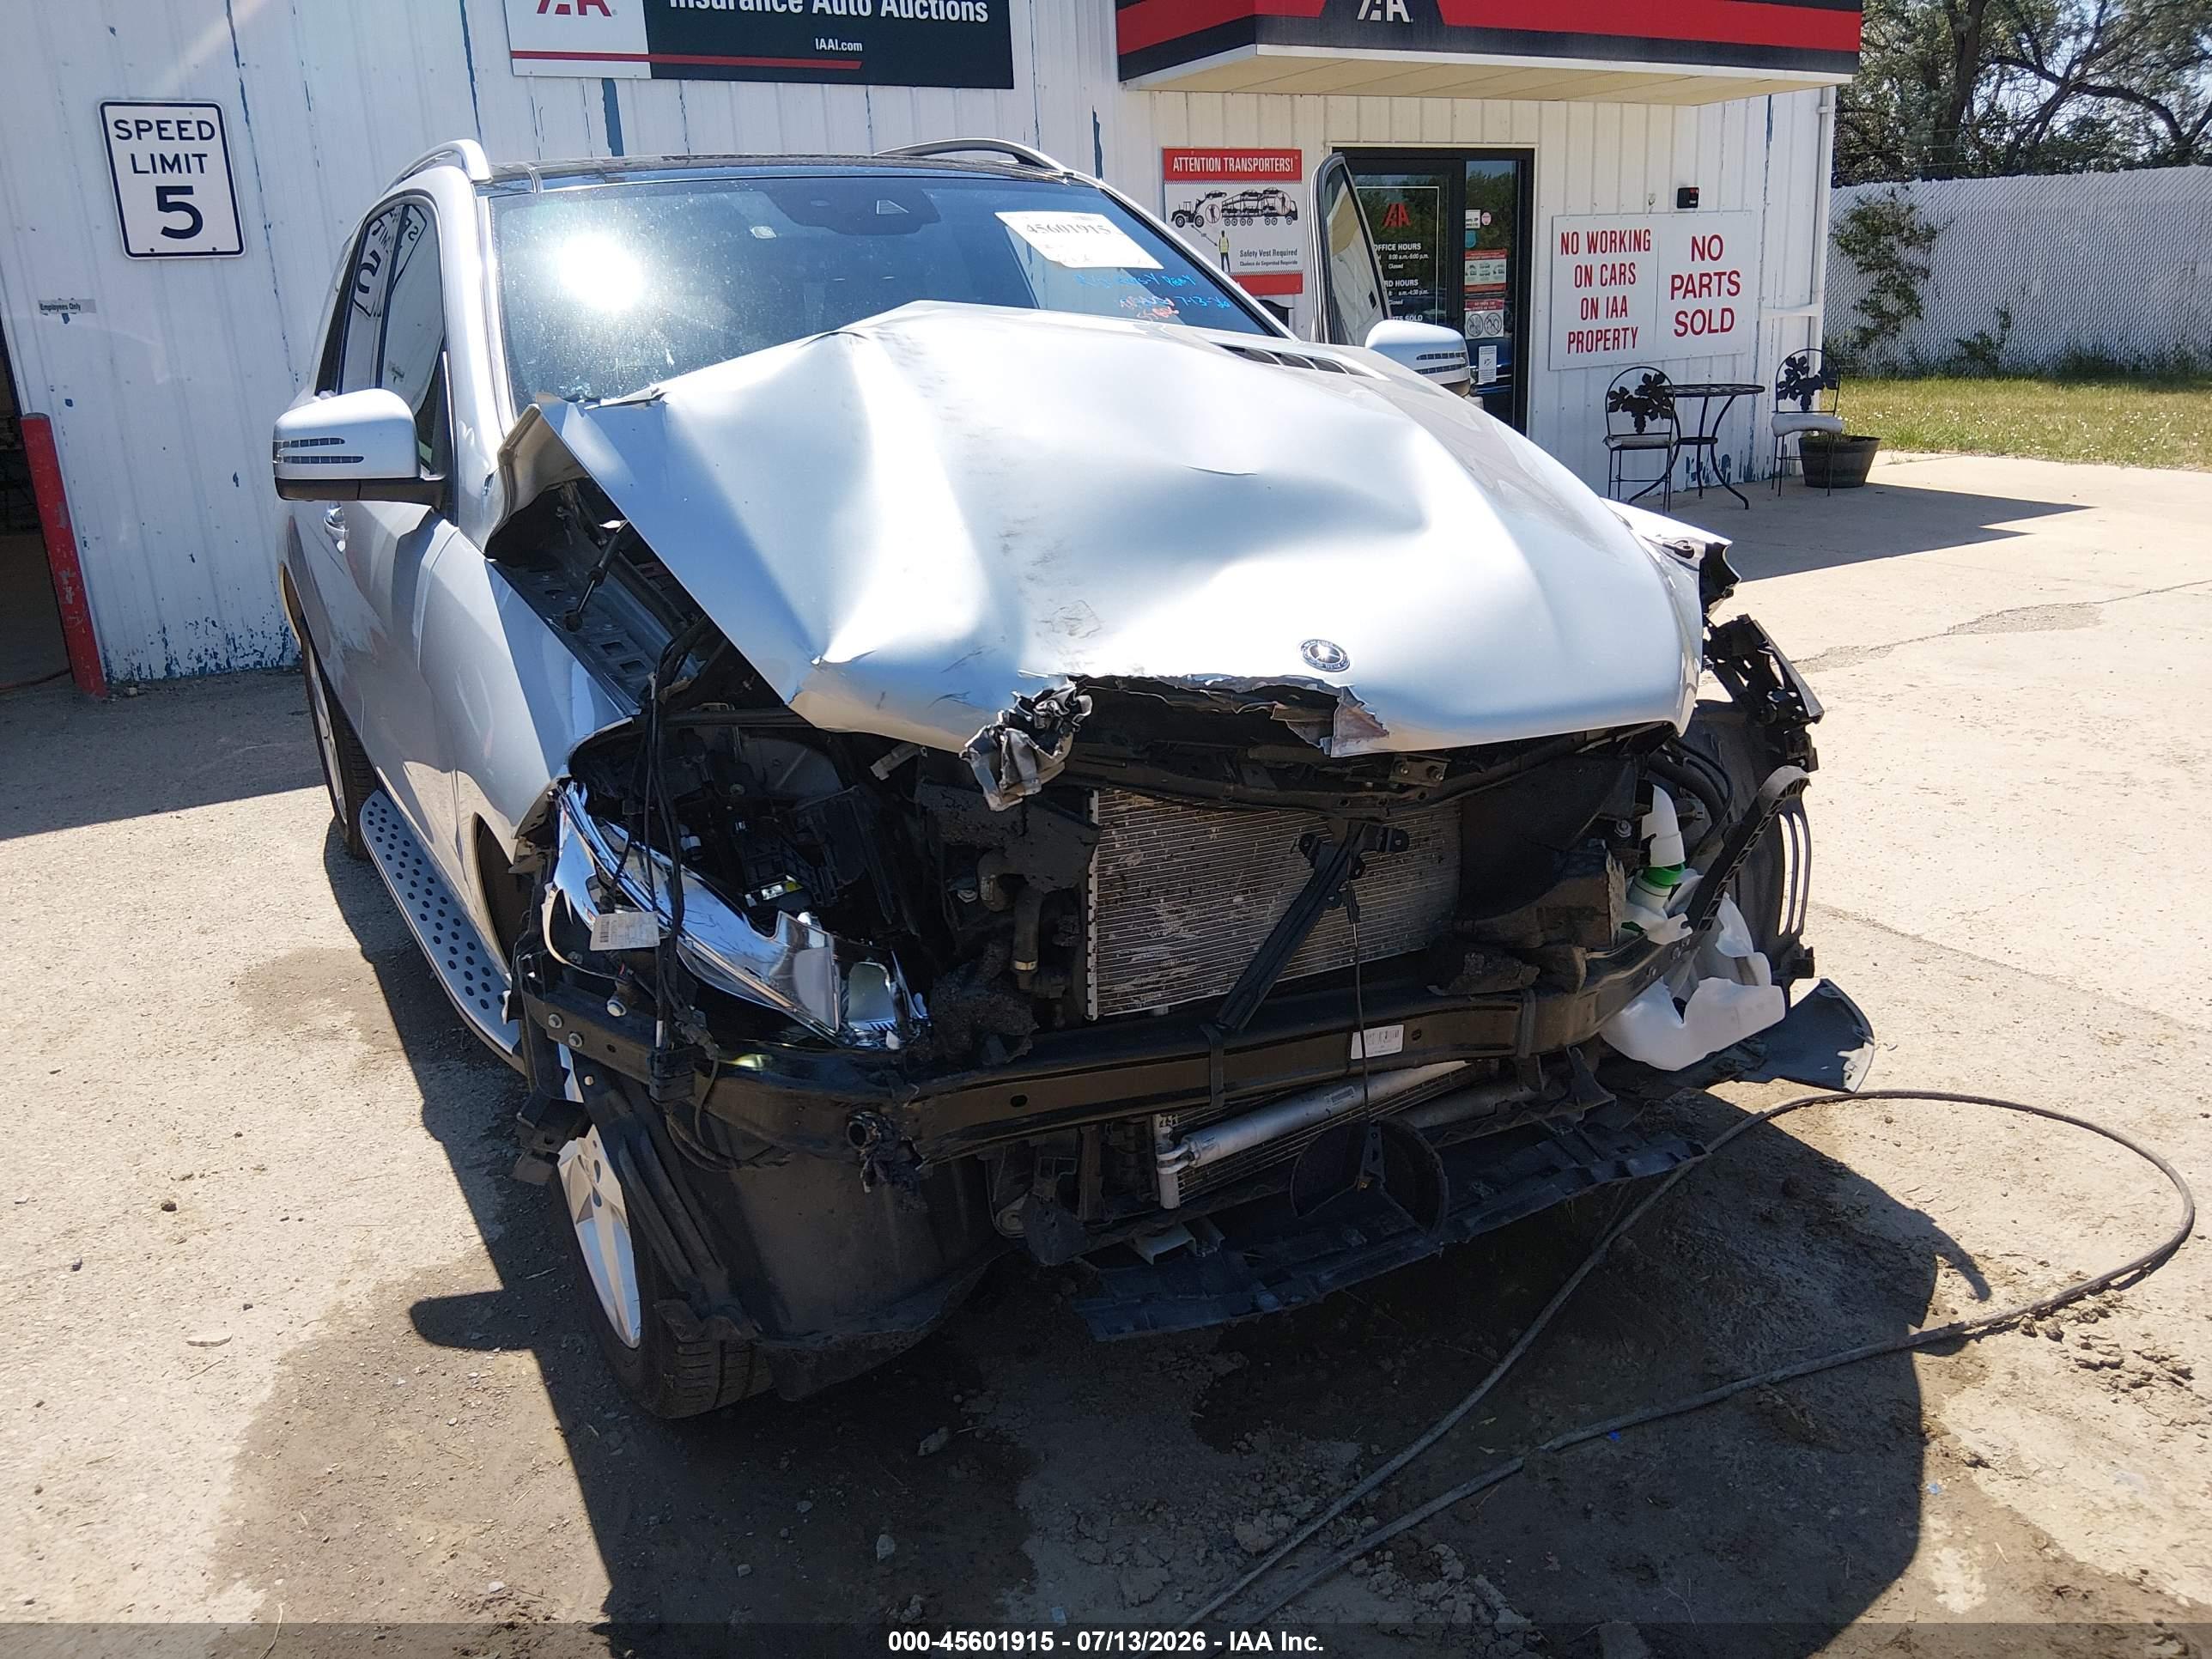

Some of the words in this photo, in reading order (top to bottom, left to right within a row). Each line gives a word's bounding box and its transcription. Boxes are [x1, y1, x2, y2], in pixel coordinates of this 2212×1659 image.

[671, 0, 803, 13] urance
[880, 0, 988, 22] Auctions
[816, 38, 863, 52] IAAI.com
[113, 118, 216, 141] SPEED
[131, 153, 208, 173] LIMIT
[1173, 156, 1221, 172] ATTENTION
[1223, 157, 1293, 173] TRANSPORTERS!
[155, 185, 204, 240] 5
[1026, 224, 1111, 234] 45601915
[1560, 231, 1579, 255] NO
[1587, 228, 1650, 254] WORKING
[1239, 249, 1257, 258] Safety
[1272, 248, 1297, 258] Required
[1691, 234, 1723, 262] NO
[1574, 264, 1593, 288] ON
[1600, 262, 1636, 287] CARS
[1670, 270, 1741, 301] PARTS
[1580, 297, 1599, 320] ON
[1606, 295, 1628, 319] IAA
[1674, 307, 1735, 337] SOLD
[1567, 326, 1638, 354] PROPERTY
